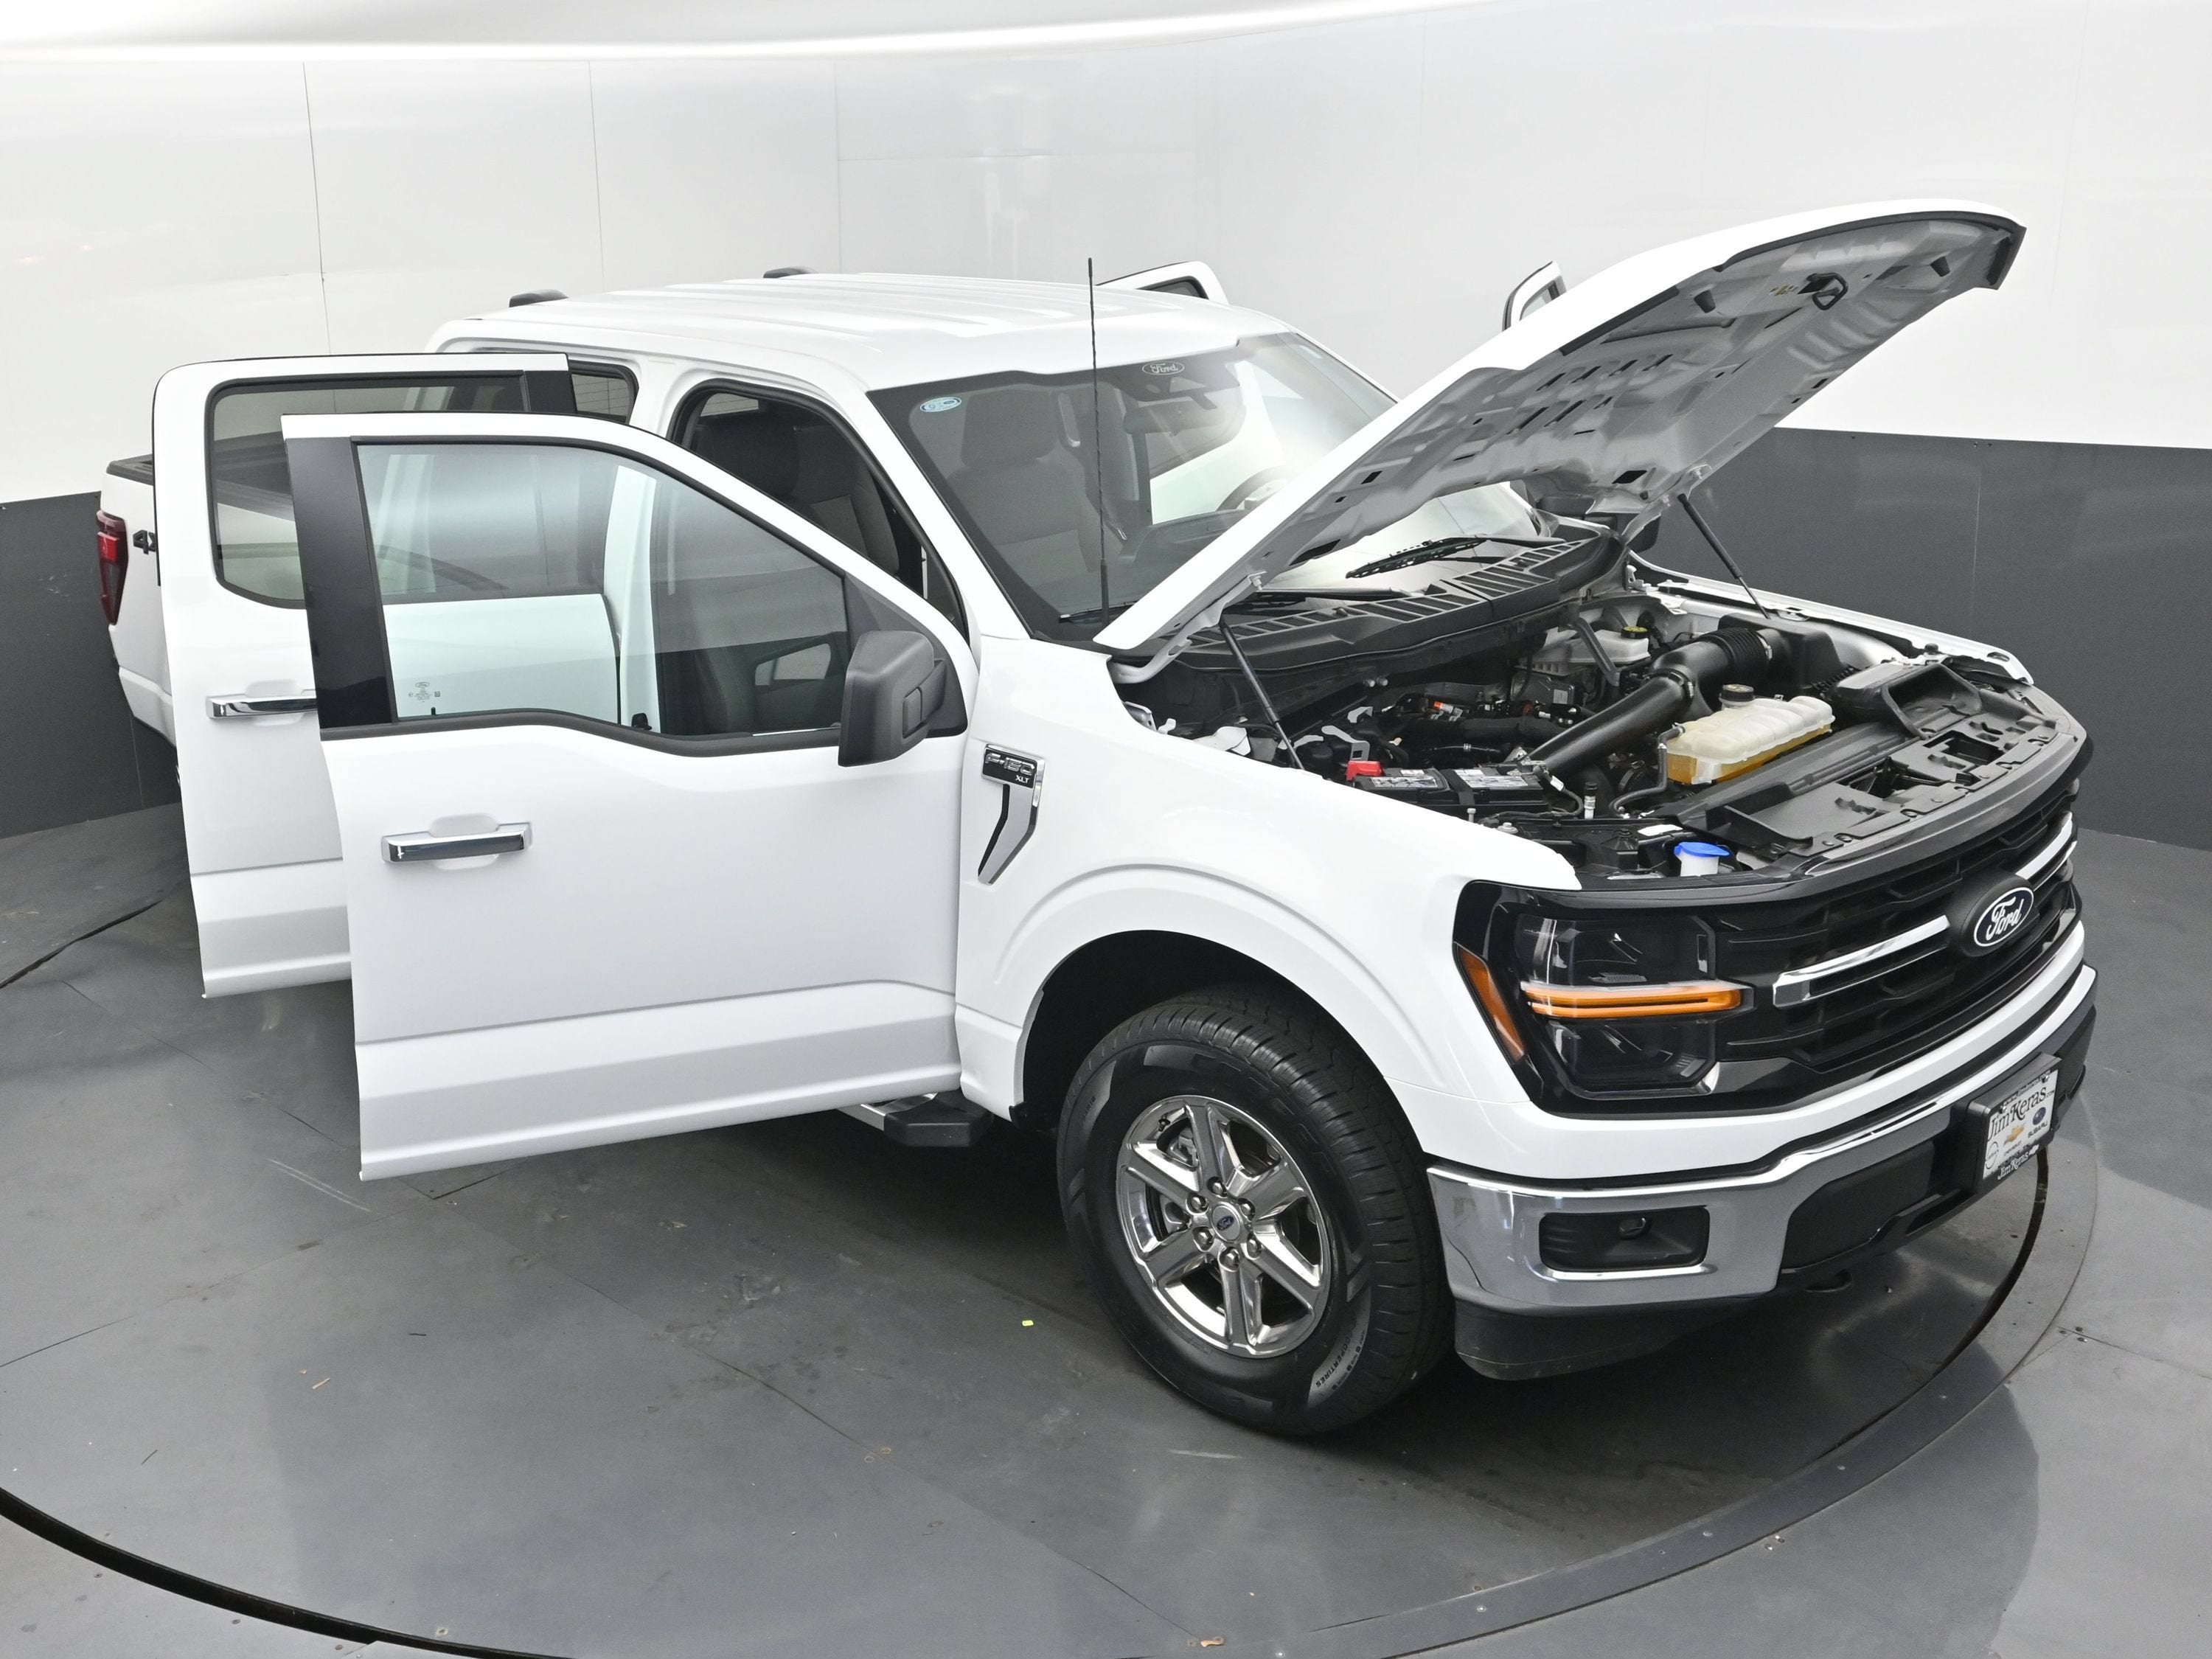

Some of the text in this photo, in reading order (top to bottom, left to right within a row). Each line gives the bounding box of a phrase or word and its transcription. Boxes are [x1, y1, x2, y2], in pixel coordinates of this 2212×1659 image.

[1150, 363, 1178, 373] Ford
[985, 753, 1035, 775] F-150
[1986, 896, 2025, 941] Ford
[2028, 1121, 2048, 1138] SUBARU
